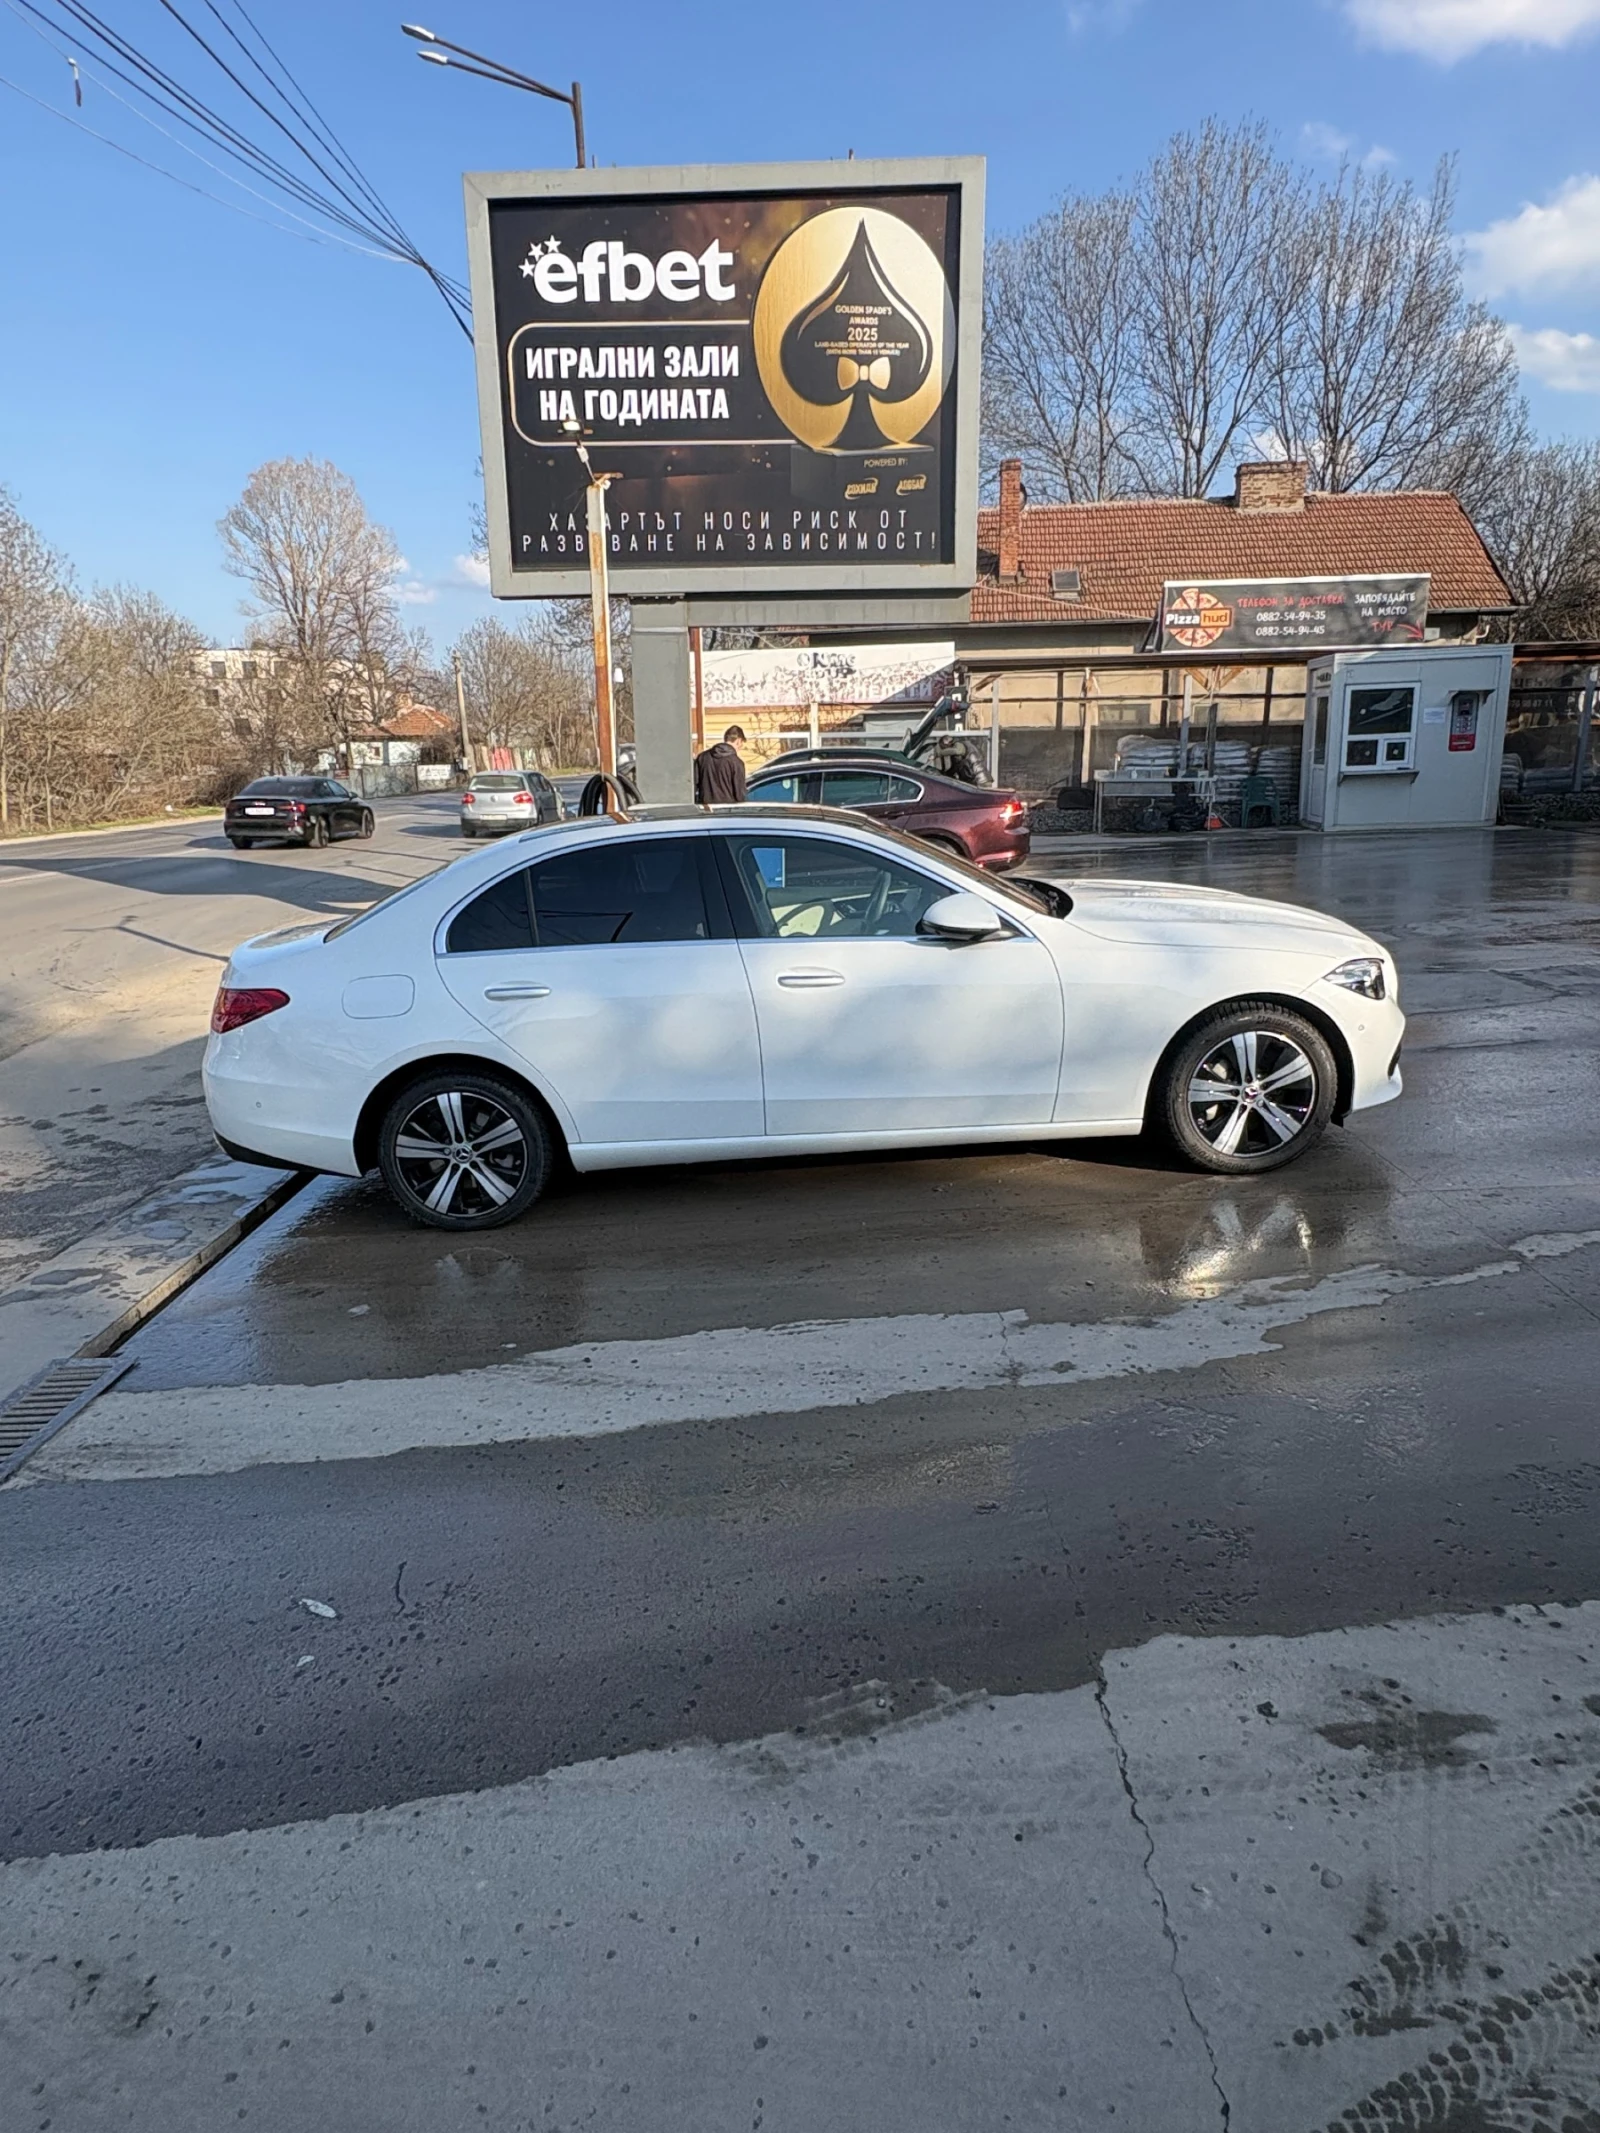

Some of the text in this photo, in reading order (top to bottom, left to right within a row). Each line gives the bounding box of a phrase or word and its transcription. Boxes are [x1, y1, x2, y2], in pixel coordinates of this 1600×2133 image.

[533, 238, 736, 304] efbet
[835, 305, 865, 315] GOLDEN
[849, 317, 879, 326] AWARDS
[847, 327, 878, 341] 2025
[525, 345, 740, 380] ИГРАЛНИ ЗАЛИ
[539, 388, 730, 427] НА ГОДИНАТА
[863, 457, 897, 468] POWERED
[548, 509, 908, 532] ХААРТЪТ НОСИ РИСК ОТ
[522, 530, 937, 553] РАЗВВАНЕ НА ЗАВИСИМОСТ!
[1237, 596, 1278, 609] ТЕЛЕФОН
[1283, 596, 1295, 606] ЗА
[1354, 590, 1416, 606] ЗАПОВЯДАЙТЕ
[1165, 610, 1229, 626] Pizza hud
[1256, 610, 1326, 622] 0882-54-94-35
[1361, 605, 1408, 617] НА МЯСТО
[1371, 619, 1394, 633] ТУК
